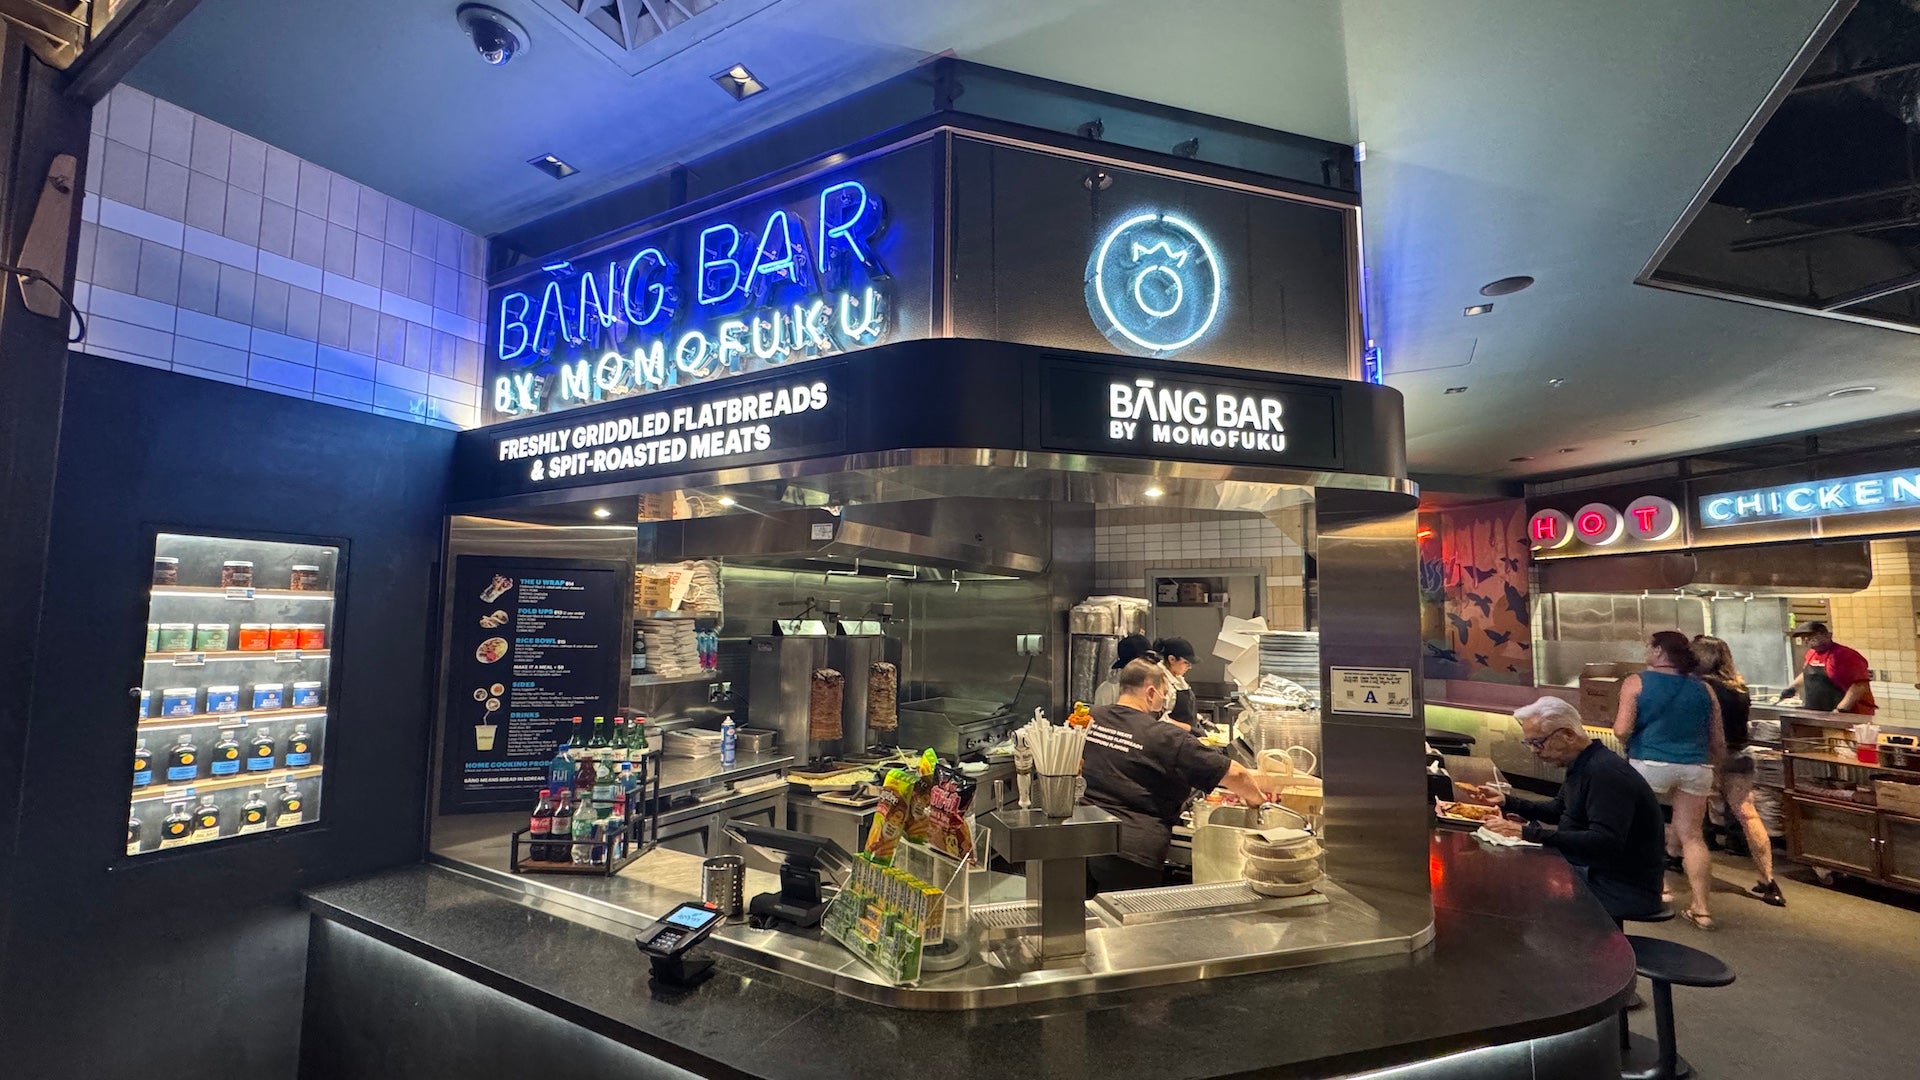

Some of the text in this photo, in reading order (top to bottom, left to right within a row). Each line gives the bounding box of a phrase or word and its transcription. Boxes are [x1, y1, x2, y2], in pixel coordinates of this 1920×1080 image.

[698, 180, 867, 305] BAR
[494, 286, 877, 415] BY MOMOFUKU
[499, 381, 829, 462] FRESHLY GRIDDLED FLATBREADS
[1215, 393, 1285, 433] BAR
[530, 424, 772, 482] & SPIT-ROASTED MEATS
[1109, 420, 1286, 452] BY MOMOFUKU
[1706, 474, 1920, 521] CHICKEN
[1534, 506, 1658, 539] HOT
[1363, 690, 1379, 704] A
[552, 770, 568, 781] FIJI
